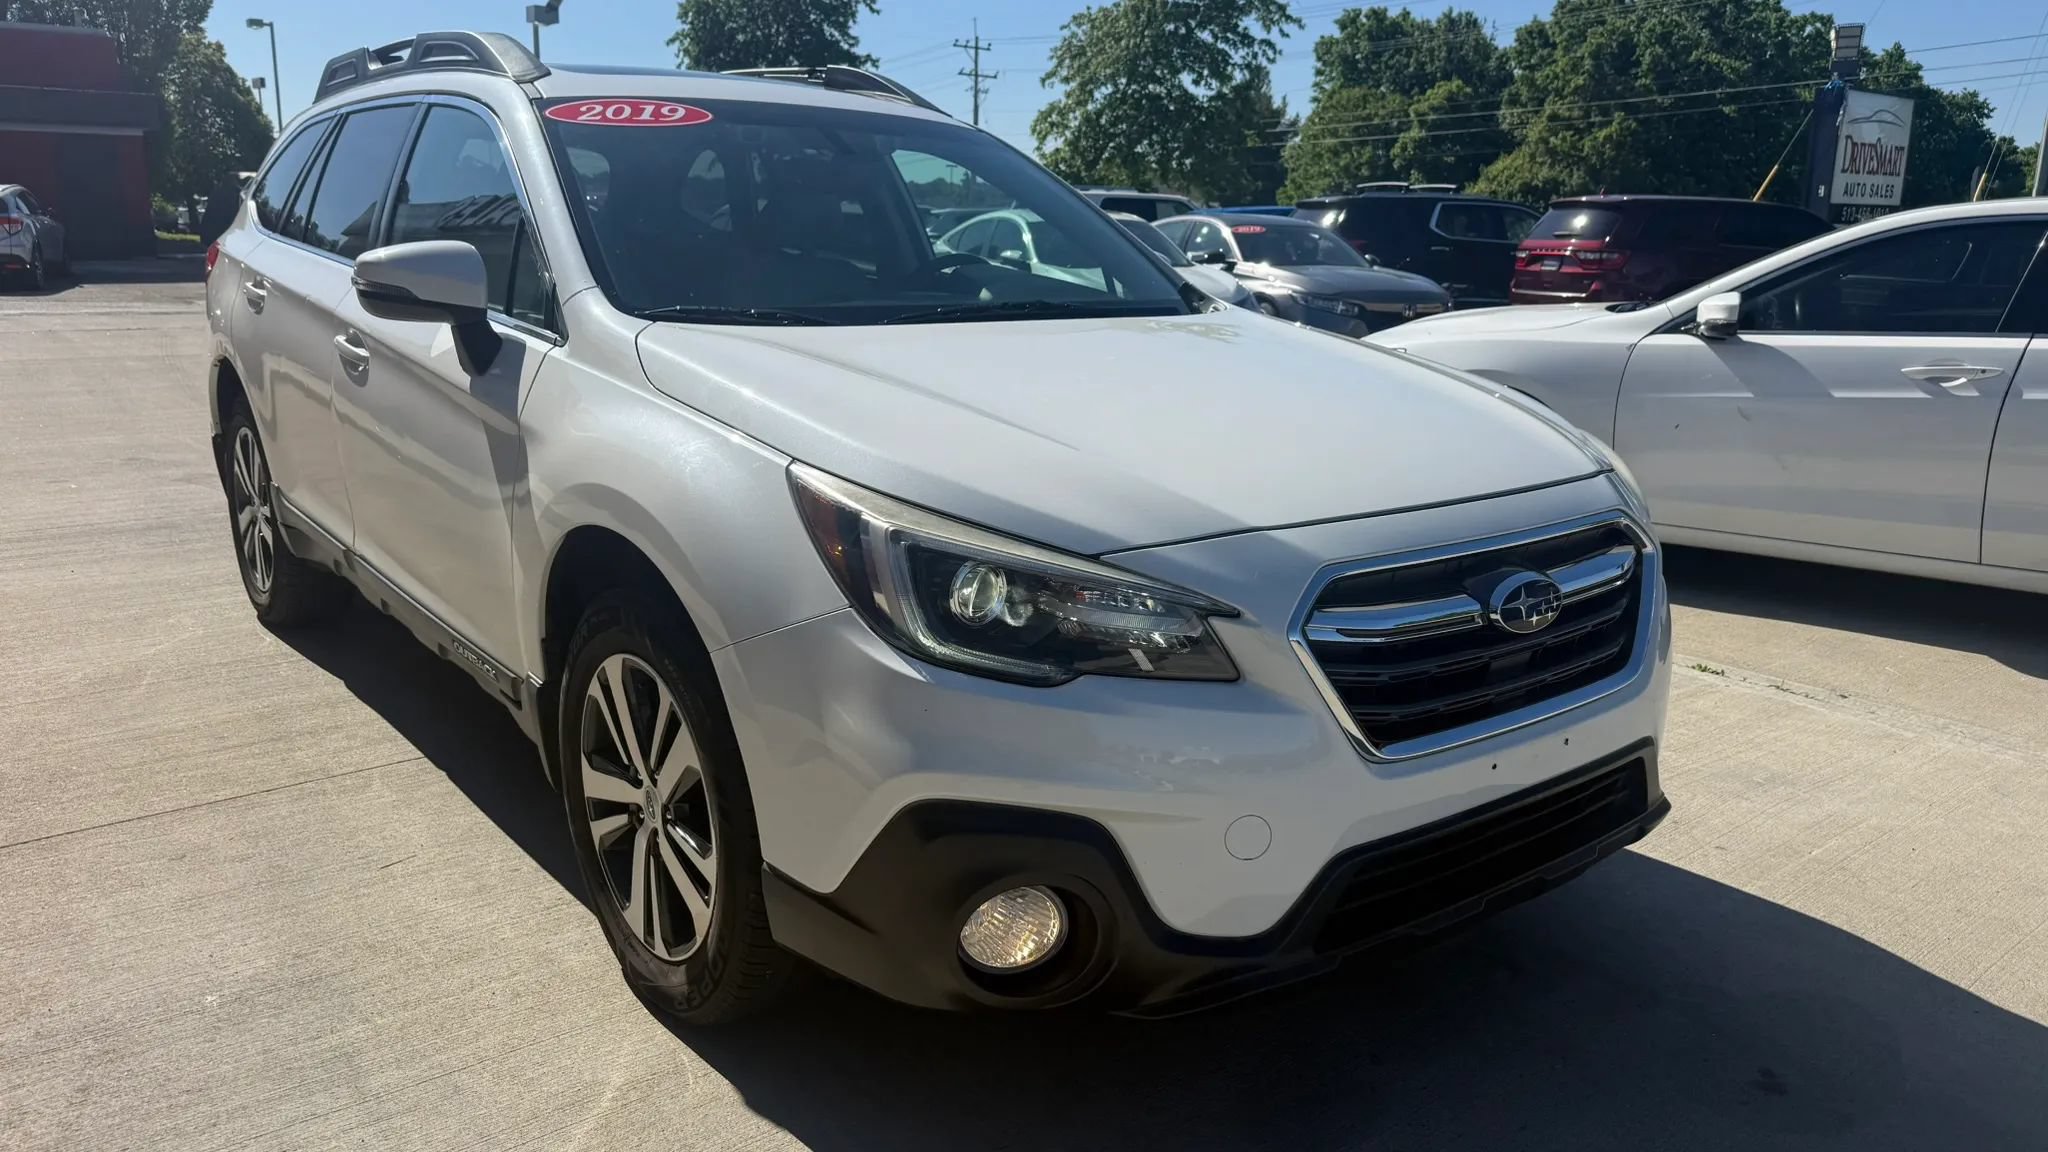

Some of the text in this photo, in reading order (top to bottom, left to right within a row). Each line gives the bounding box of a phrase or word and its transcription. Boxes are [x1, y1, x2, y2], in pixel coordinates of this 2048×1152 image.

[577, 104, 686, 121] 2019
[1843, 182, 1894, 199] AUTO SALES
